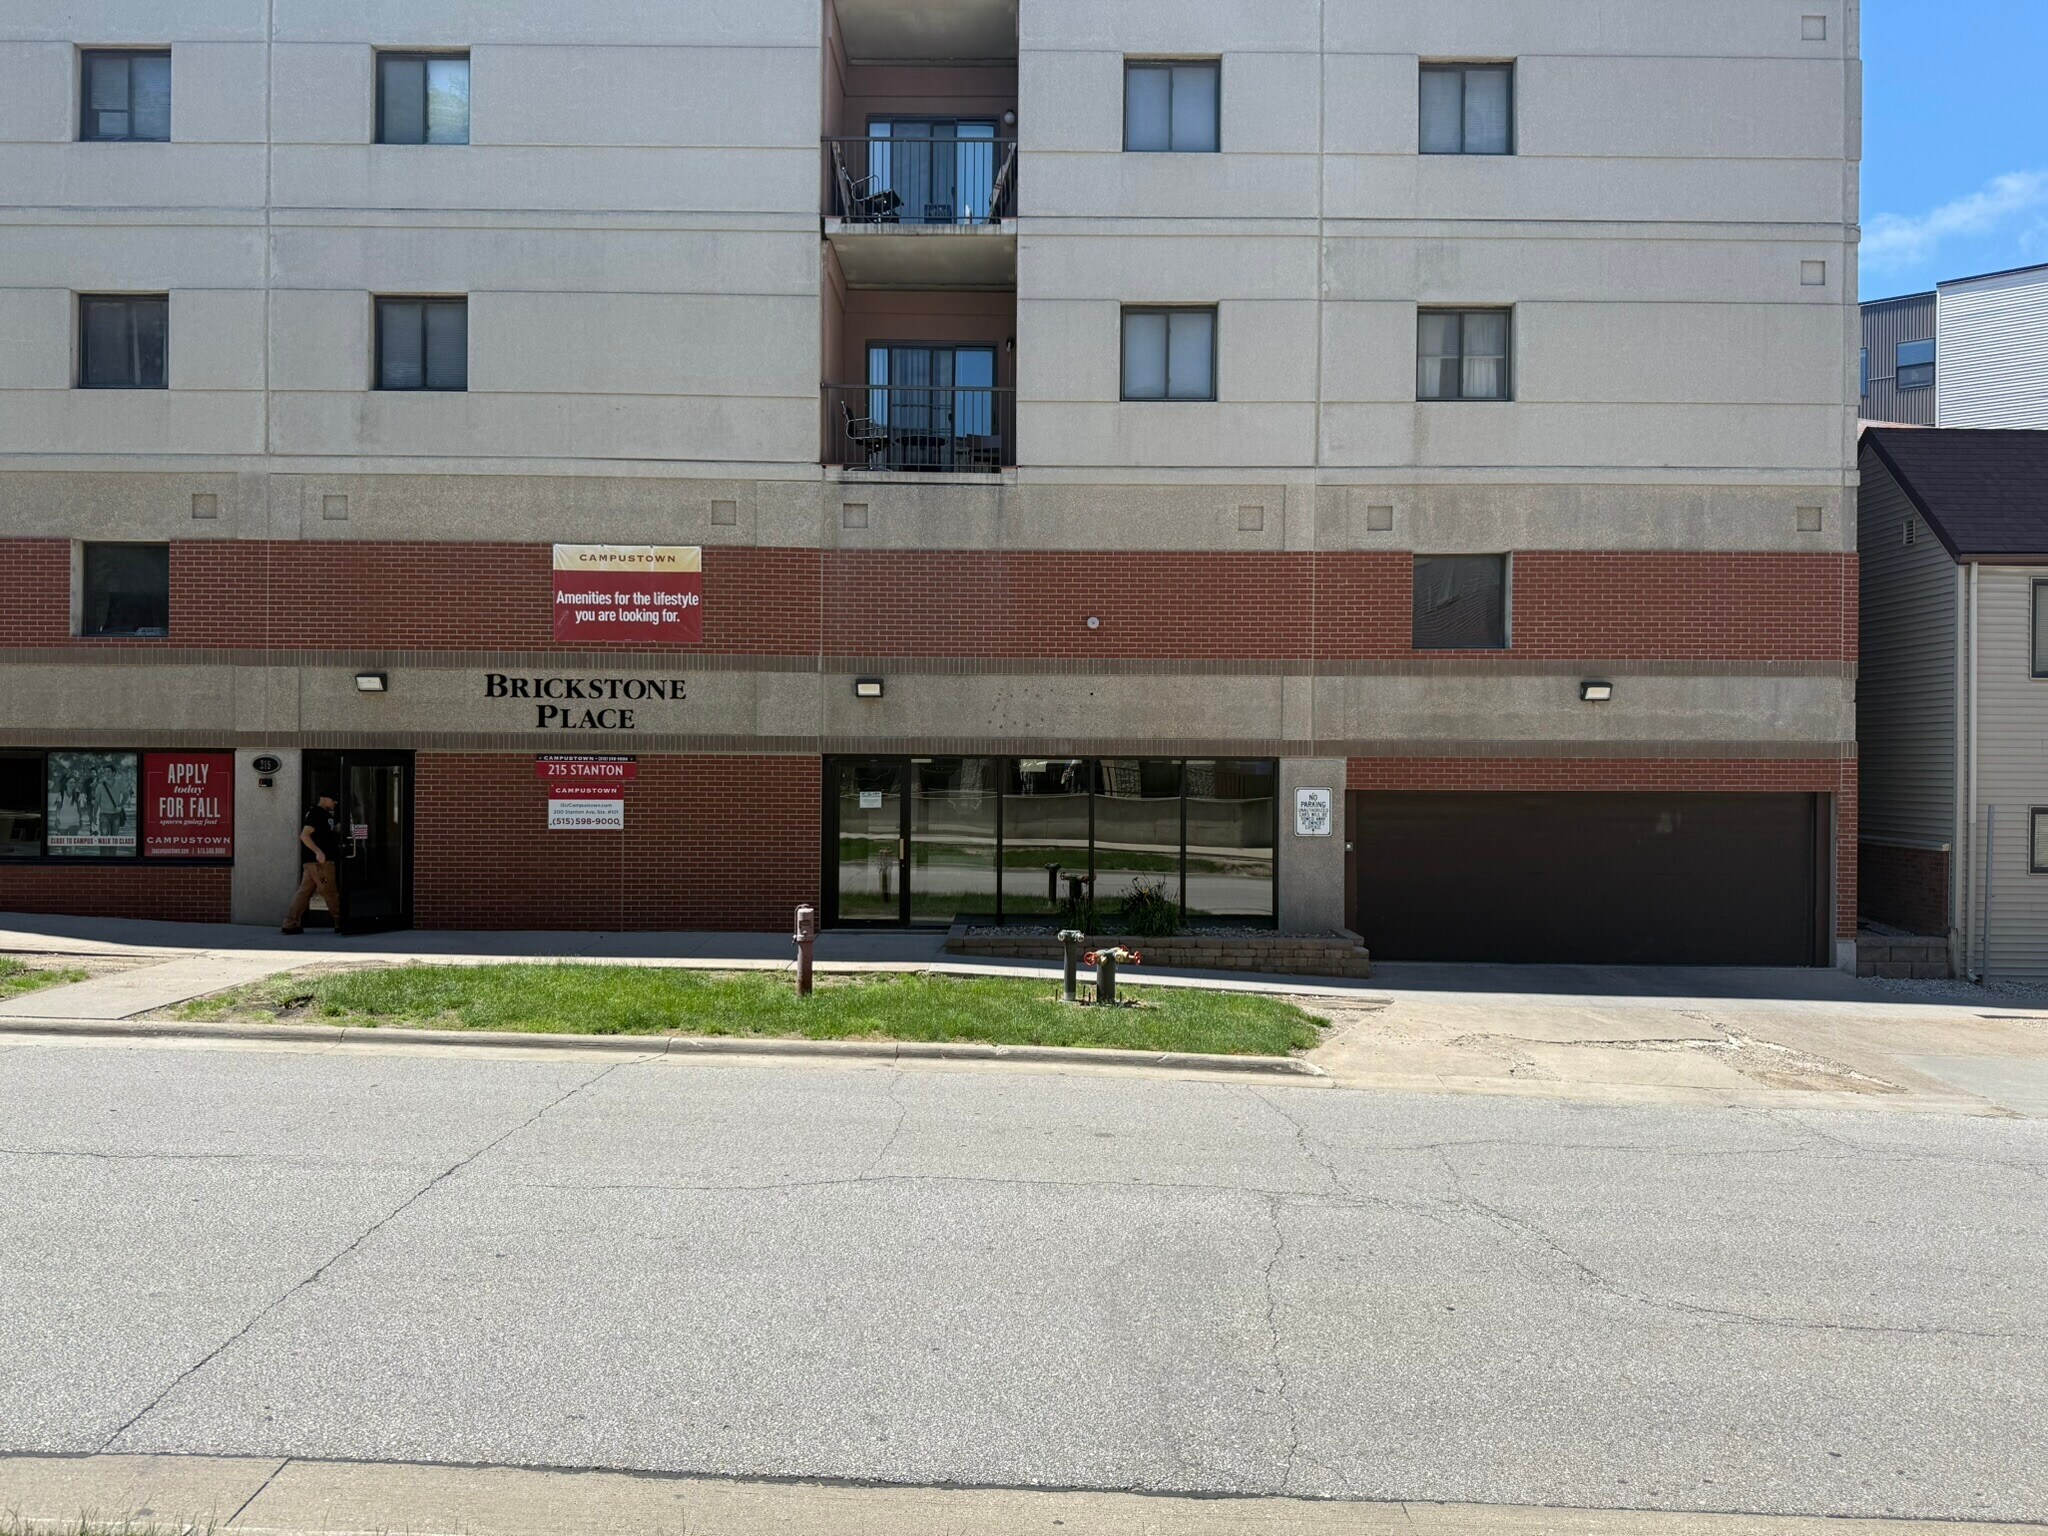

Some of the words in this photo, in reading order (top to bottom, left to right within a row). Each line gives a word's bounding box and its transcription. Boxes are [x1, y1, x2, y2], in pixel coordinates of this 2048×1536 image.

[580, 554, 676, 562] CAMPUSTOWN
[556, 590, 612, 604] Amenities
[614, 591, 630, 605] for
[633, 592, 650, 606] the
[654, 592, 699, 608] lifestyle
[575, 610, 595, 624] you
[598, 610, 616, 622] are
[619, 608, 659, 625] looking
[662, 609, 680, 622] for.
[484, 674, 686, 700] BRICKSTONE
[536, 704, 634, 728] PLACE
[168, 764, 209, 784] APPLY
[548, 764, 567, 775] 215
[570, 764, 624, 776] STANTON
[174, 785, 204, 796] today
[160, 797, 184, 818] FOR
[190, 797, 221, 818] FALL
